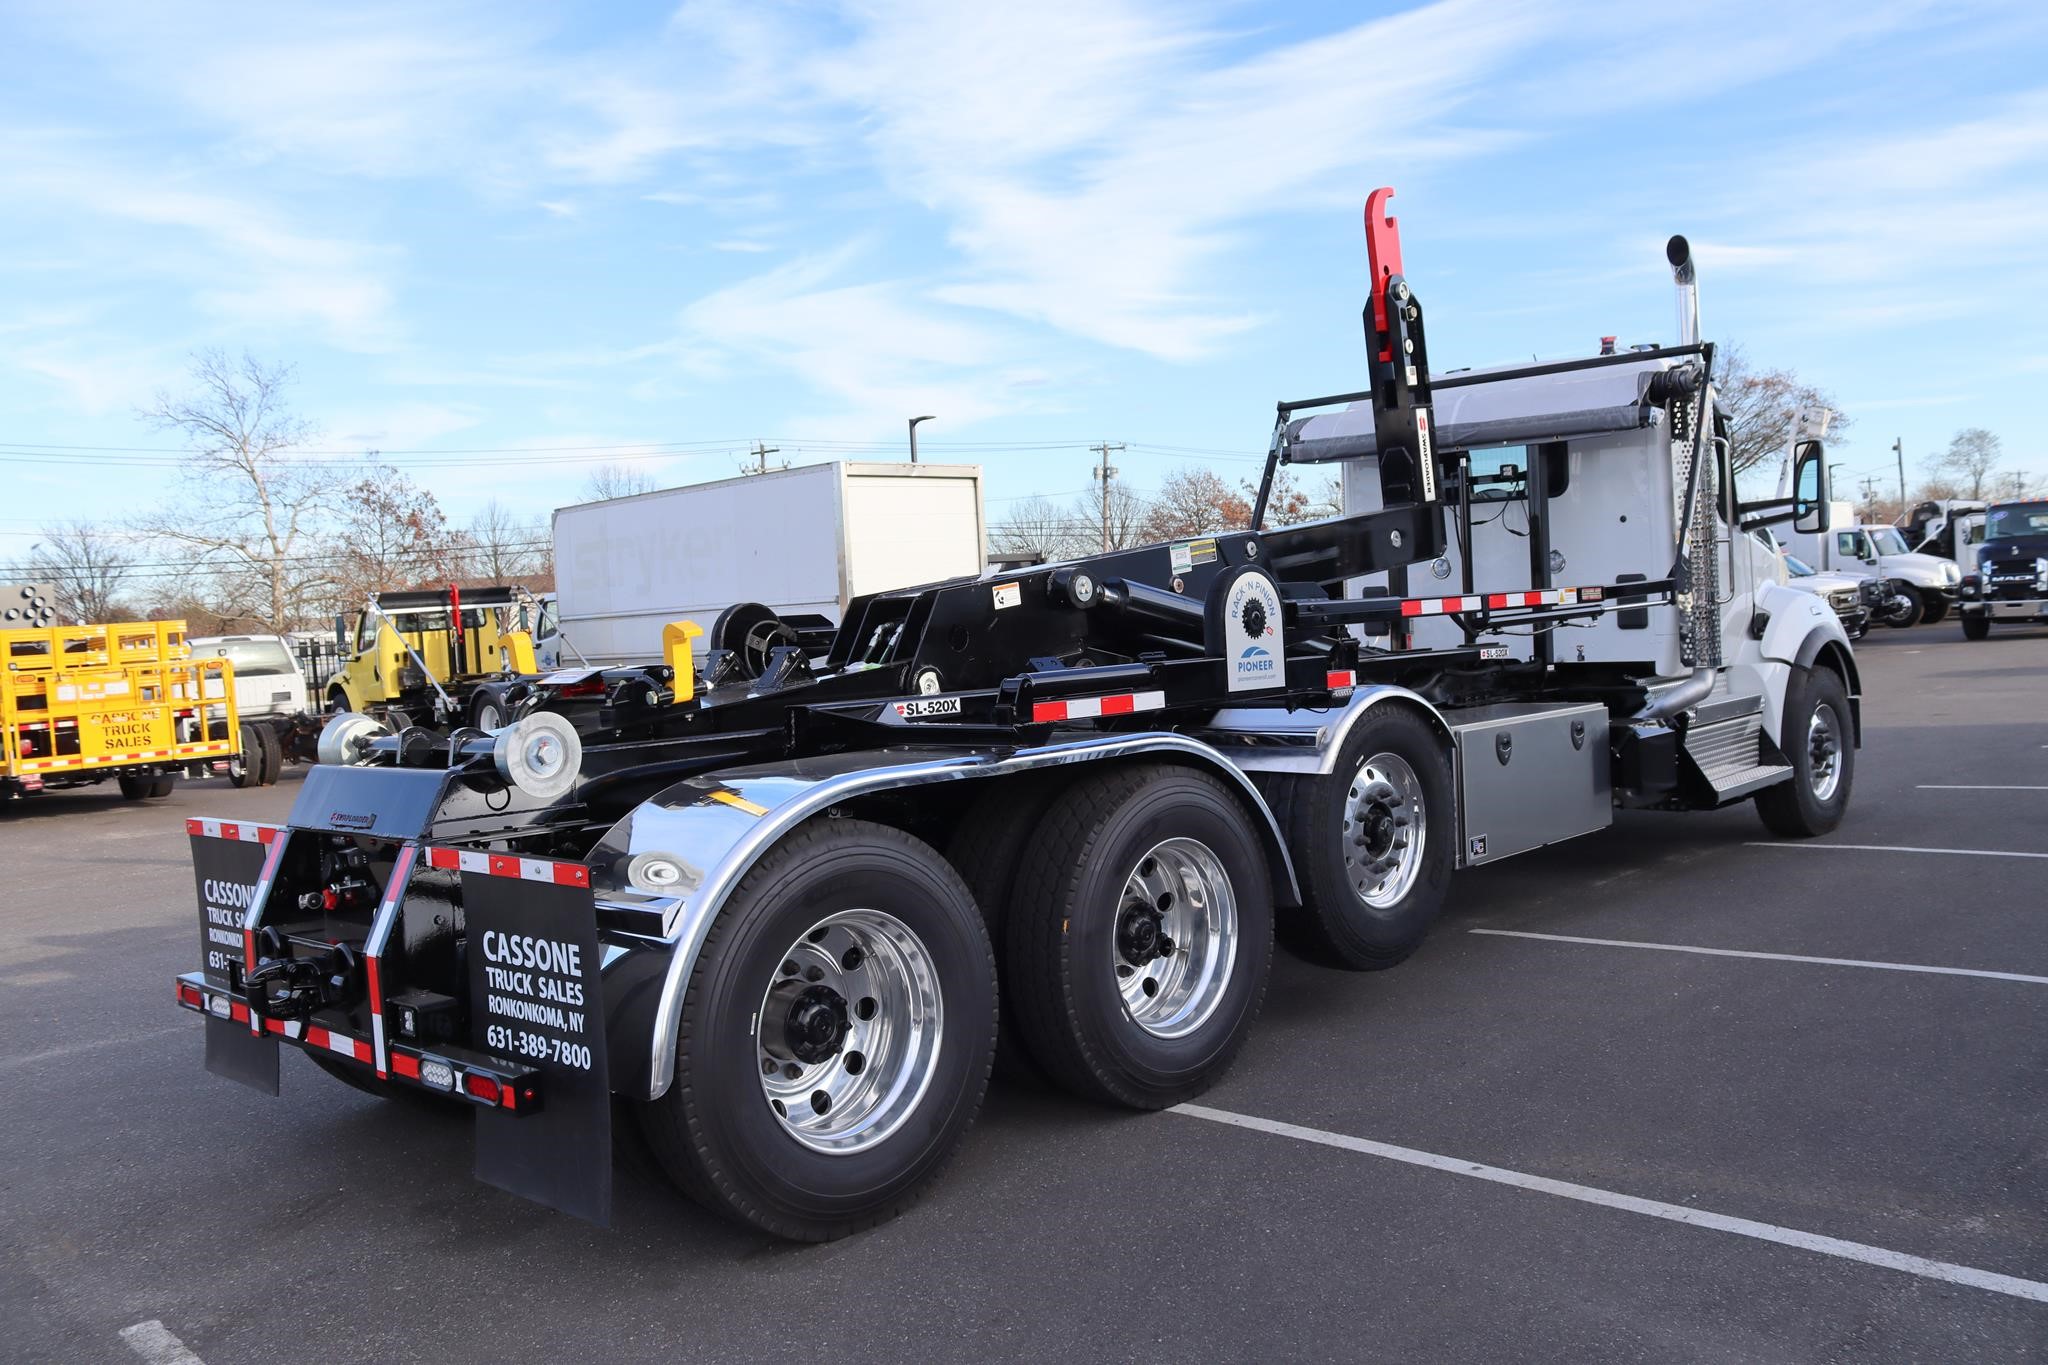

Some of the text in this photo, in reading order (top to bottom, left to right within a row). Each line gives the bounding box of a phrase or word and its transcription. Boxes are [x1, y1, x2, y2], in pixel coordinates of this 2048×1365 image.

[1421, 433, 1432, 494] SWAPLOADER
[1231, 586, 1246, 619] RACK
[1255, 581, 1276, 618] PINION
[1238, 660, 1274, 673] PIONEER
[102, 722, 151, 737] TRUCK
[105, 735, 152, 750] SALES
[206, 906, 234, 929] TRUCK
[483, 930, 582, 978] CASSONE
[485, 966, 584, 1006] TRUCK SALES
[488, 994, 584, 1033] RONKONKOMA, NY
[487, 1024, 591, 1070] 631-389-7800
